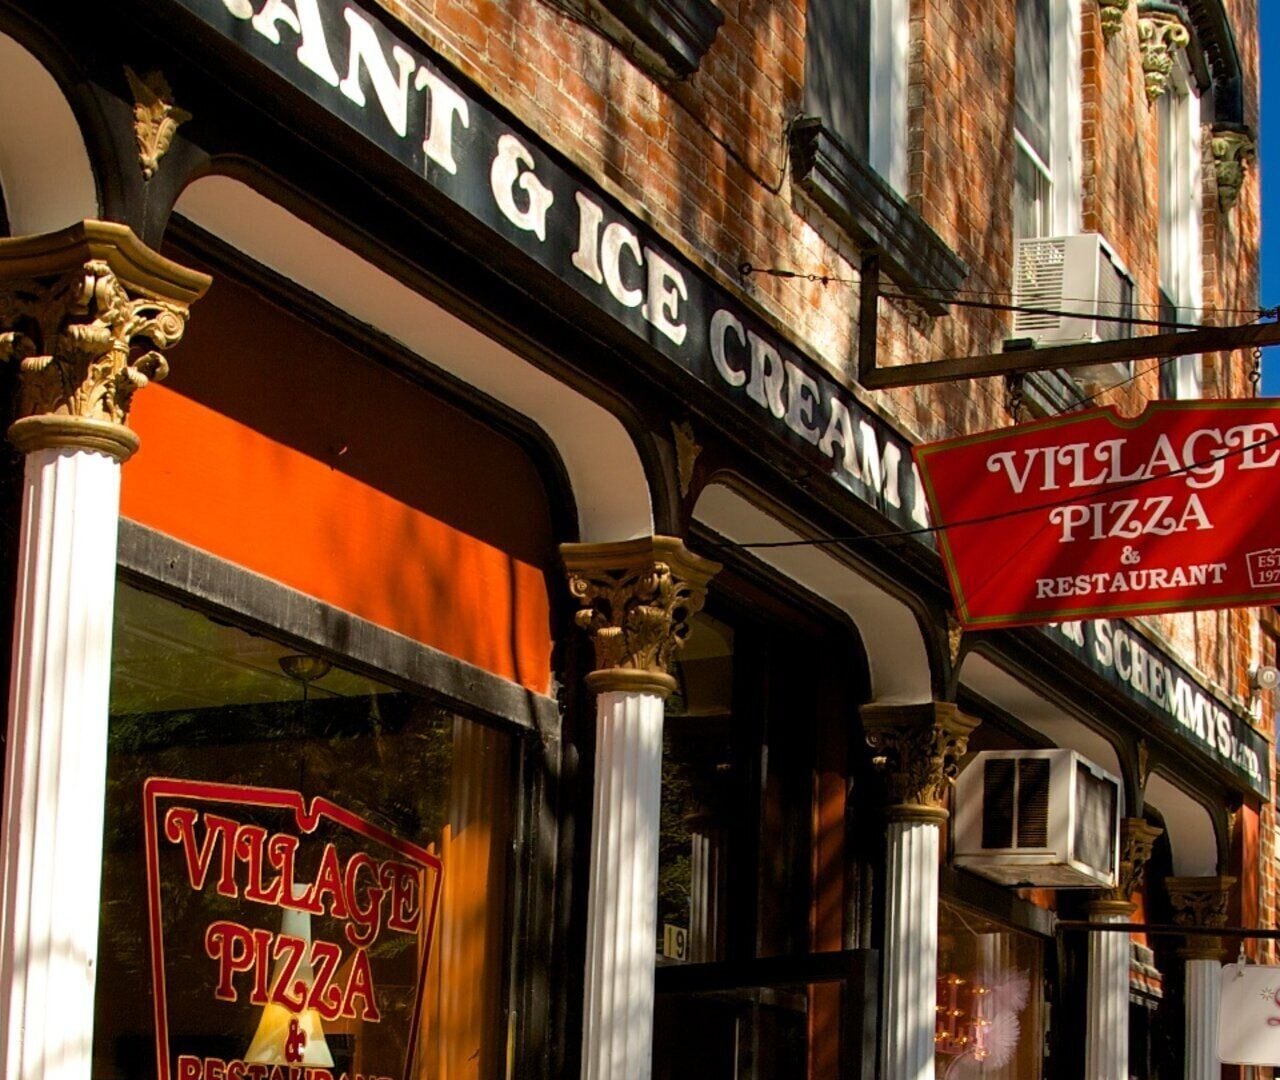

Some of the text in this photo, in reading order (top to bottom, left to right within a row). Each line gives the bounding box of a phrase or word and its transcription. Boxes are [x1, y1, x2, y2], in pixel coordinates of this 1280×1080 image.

[490, 134, 553, 242] &
[572, 191, 688, 346] ICE
[710, 309, 901, 509] CREAM
[987, 422, 1280, 494] VILLAGE
[1049, 493, 1214, 543] PIZZA
[1036, 563, 1227, 599] RESTAURANT
[1121, 546, 1140, 564] &
[164, 807, 420, 950] VILLAGE
[205, 921, 381, 1022] PIZZA
[285, 1019, 306, 1063] &
